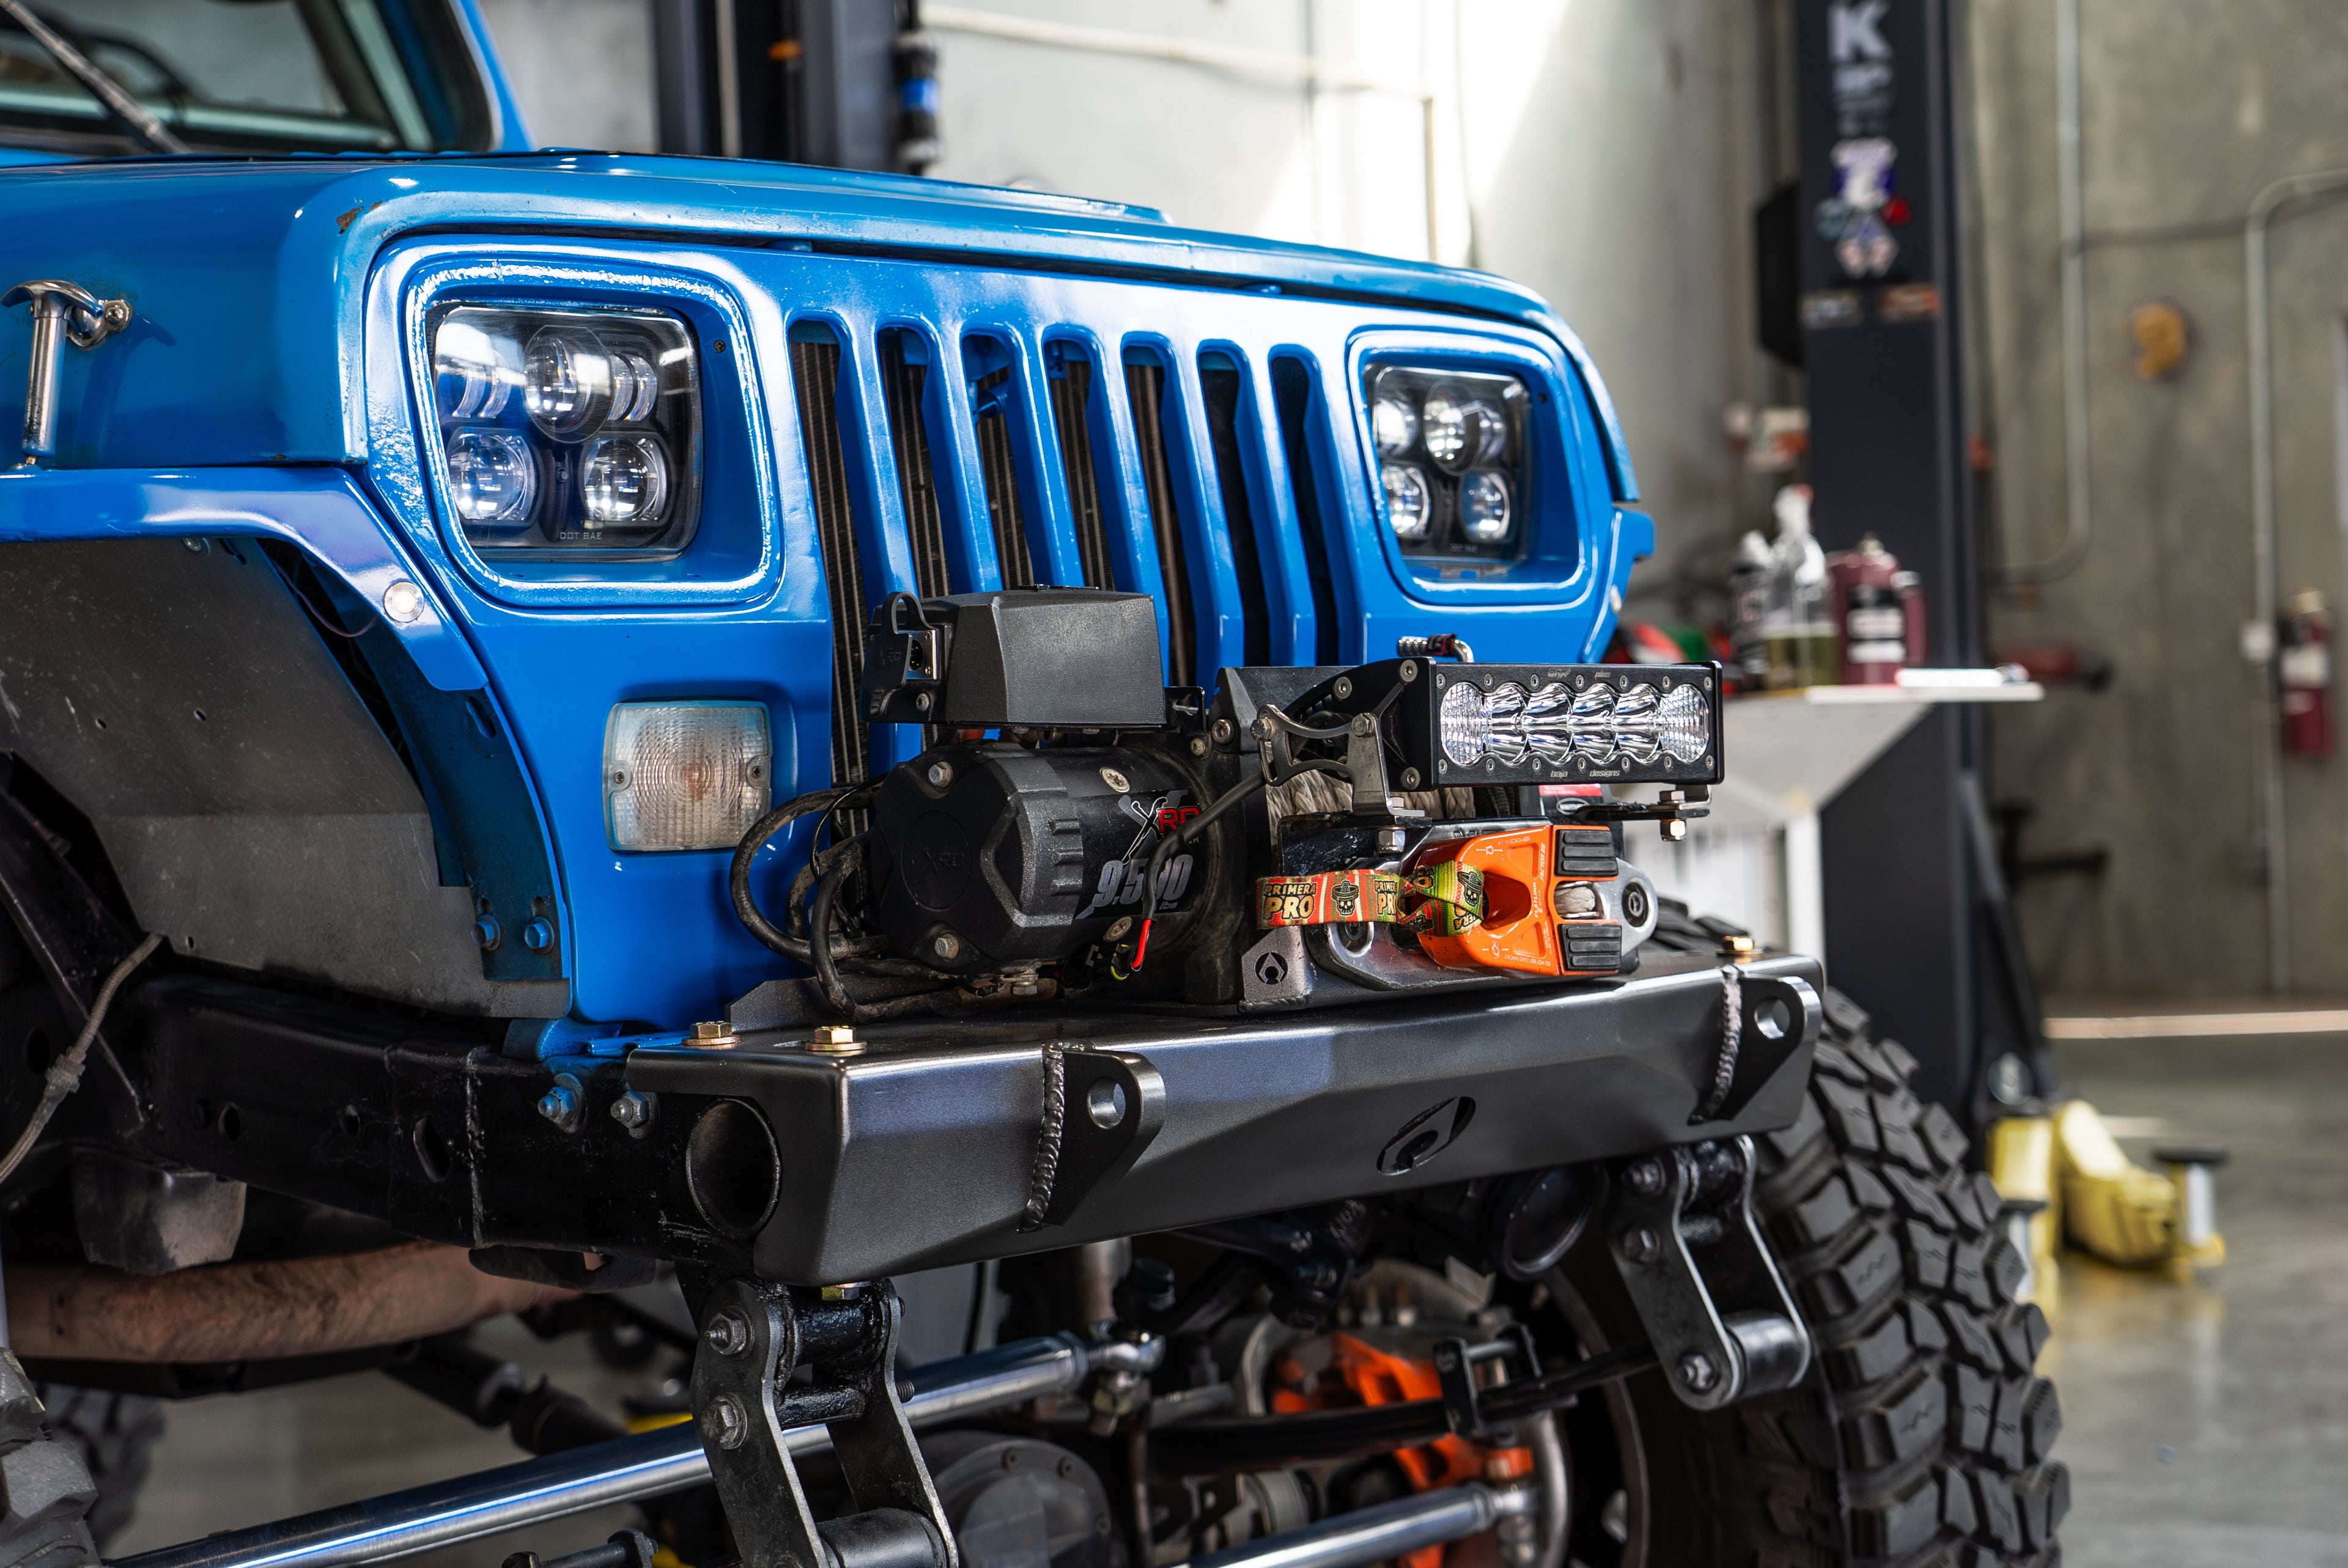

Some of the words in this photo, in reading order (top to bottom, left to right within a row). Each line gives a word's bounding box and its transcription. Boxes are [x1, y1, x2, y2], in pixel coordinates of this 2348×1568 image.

[739, 841, 754, 870] 72553
[1264, 883, 1316, 896] PRIMERA
[1263, 896, 1316, 919] PRO
